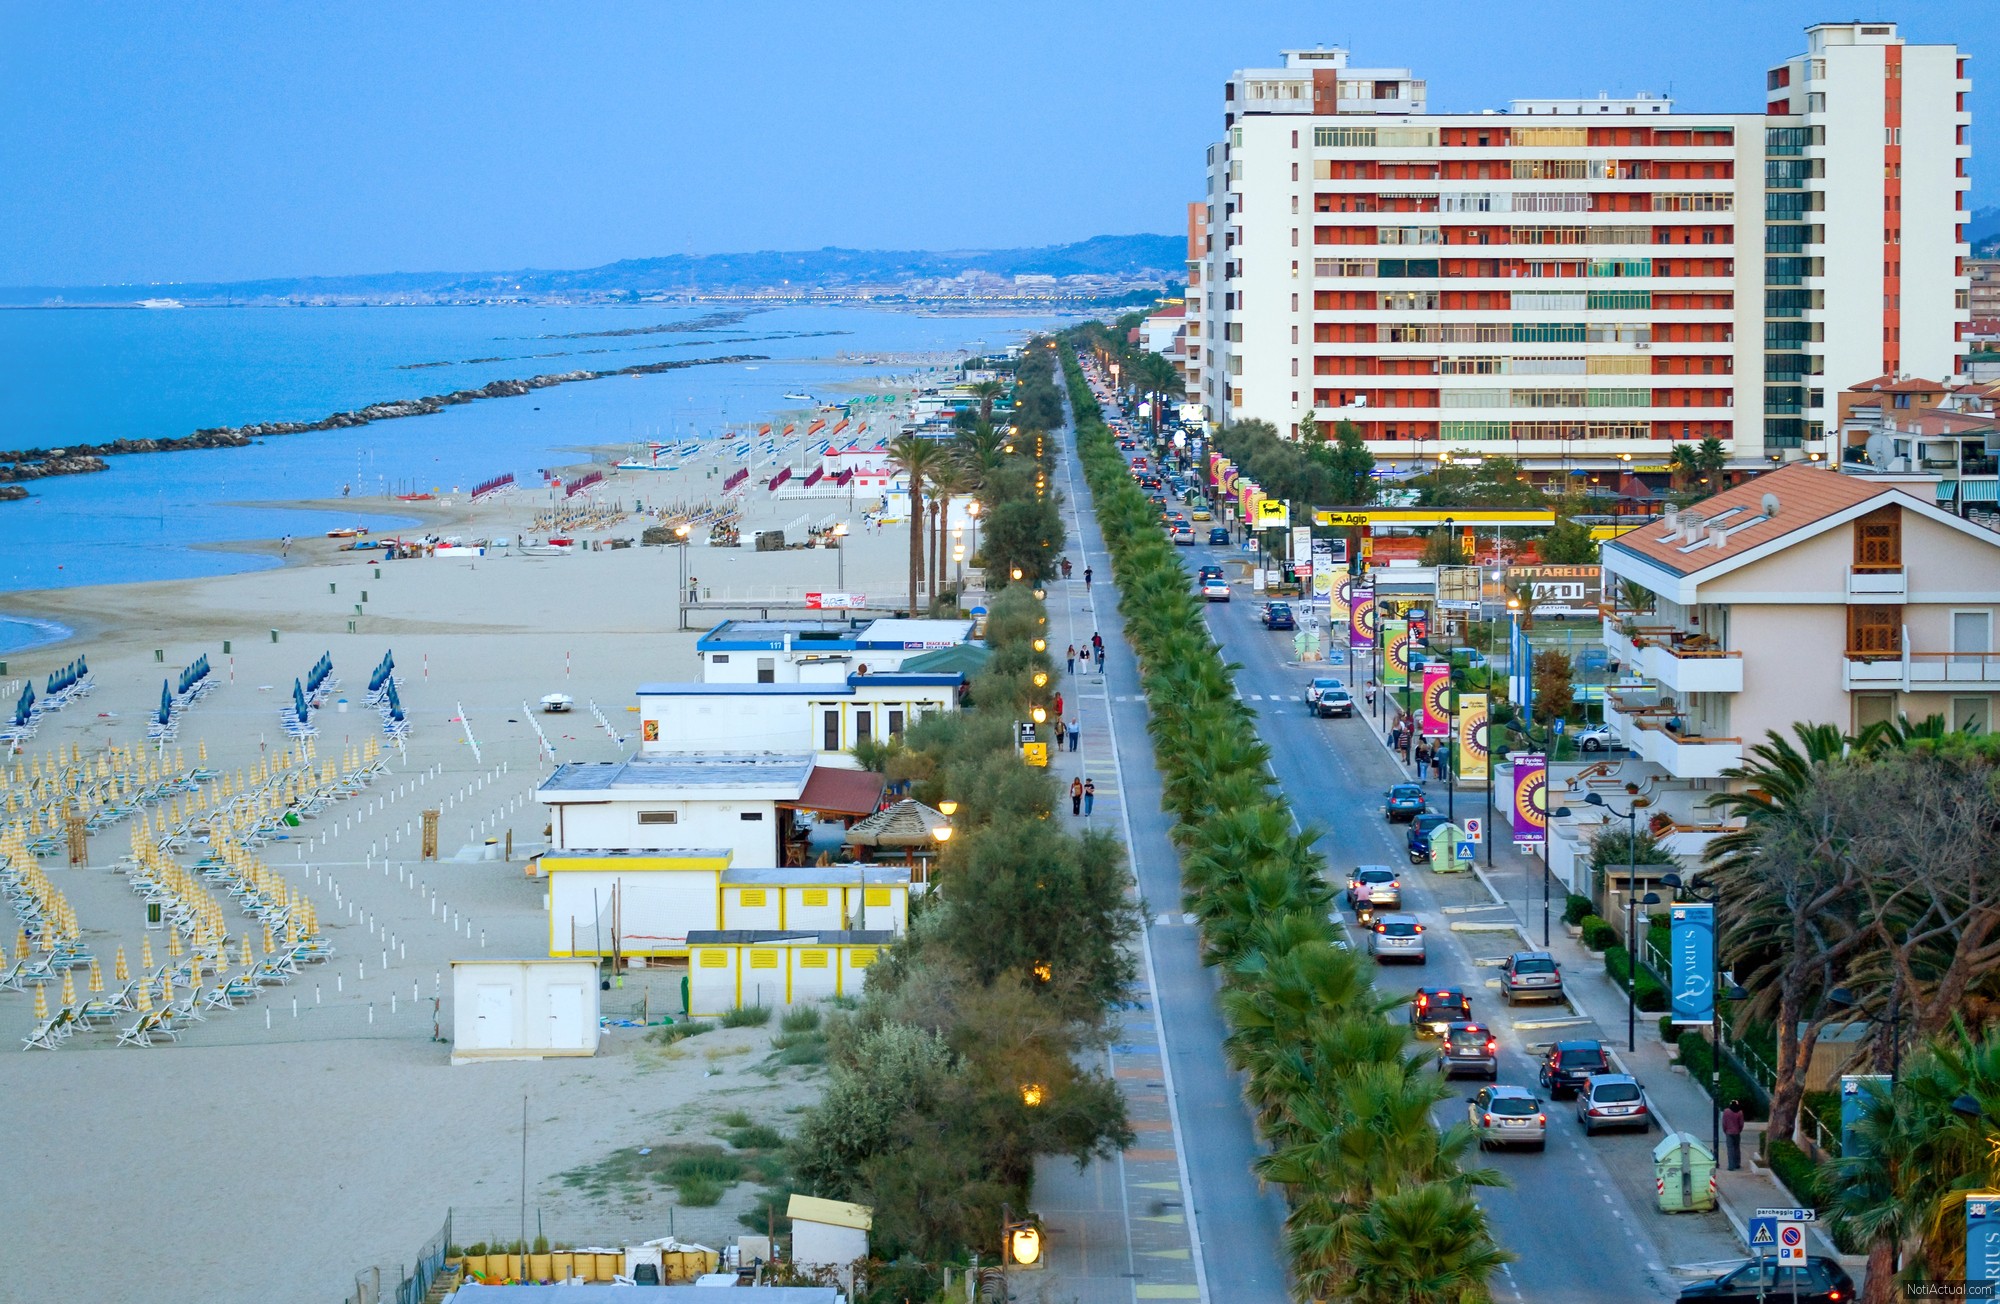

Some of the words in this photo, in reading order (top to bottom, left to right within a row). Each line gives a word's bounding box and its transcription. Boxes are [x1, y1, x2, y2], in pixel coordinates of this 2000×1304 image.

[1345, 514, 1368, 525] Agip
[1510, 567, 1599, 577] PITTARELLO
[1525, 585, 1581, 597] ALDI
[769, 641, 782, 650] 117
[1675, 930, 1711, 1007] AQUARIUS
[1757, 1208, 1794, 1216] parcheggio
